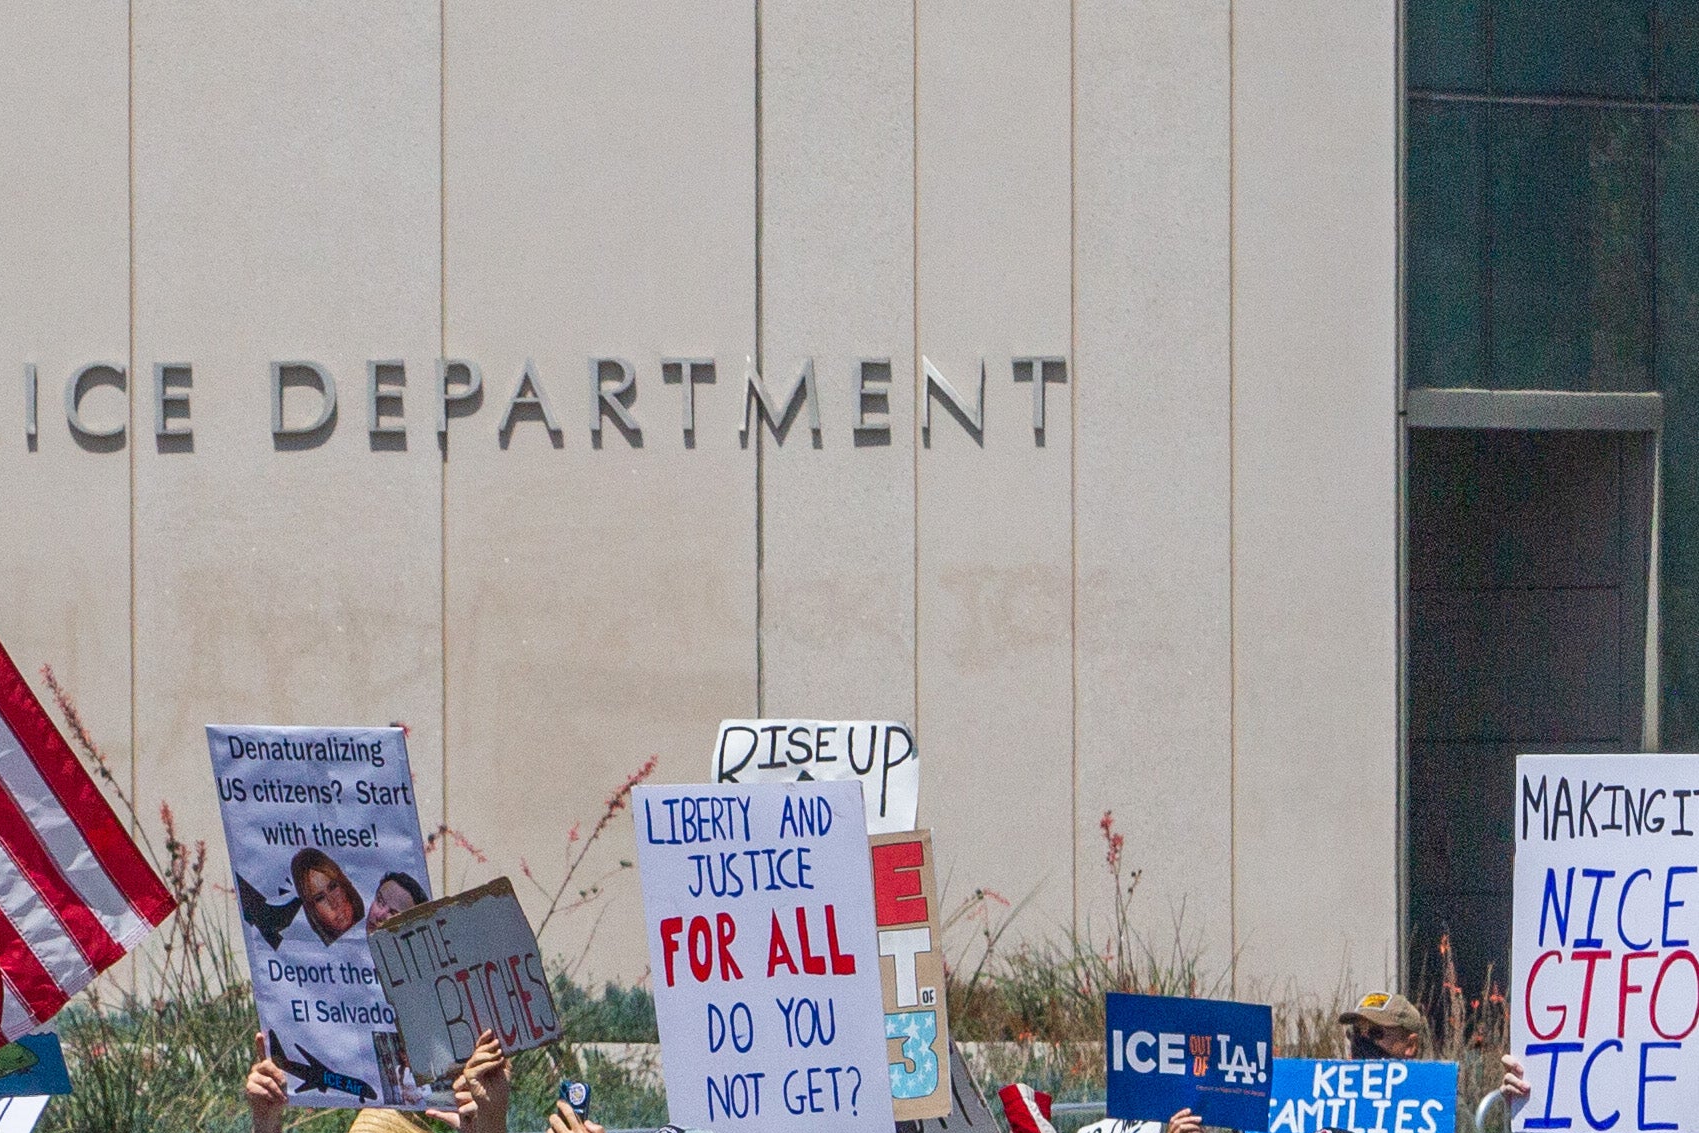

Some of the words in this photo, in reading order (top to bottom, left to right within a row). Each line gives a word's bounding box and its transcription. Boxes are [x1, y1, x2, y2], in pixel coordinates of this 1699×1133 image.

[270, 355, 1068, 452] DEPARTMENT
[228, 735, 385, 767] Denaturalizing
[217, 777, 247, 802] US
[253, 779, 343, 804] citizens?
[355, 780, 413, 806] Start
[1522, 774, 1667, 842] MAKING
[1672, 790, 1699, 837] I
[262, 821, 306, 847] with
[312, 823, 379, 848] these!
[645, 796, 751, 845] LIBERTY
[779, 795, 832, 839] AND
[688, 847, 814, 898] JUSTICE
[1538, 866, 1699, 951] NICE
[376, 920, 458, 988] LITTLE
[660, 911, 744, 987] FOR
[767, 904, 857, 978] ALL
[268, 959, 335, 988] Deport
[1525, 950, 1699, 1041] GTFO
[292, 1000, 311, 1023] El
[316, 999, 396, 1027] Salvado
[434, 953, 558, 1064] BITCHES
[708, 1002, 754, 1054] DO
[776, 997, 836, 1049] YOU
[1112, 1029, 1187, 1076] ICE
[1189, 1034, 1212, 1055] OUT
[1193, 1055, 1210, 1077] OF
[1217, 1034, 1268, 1084] LA!
[706, 1072, 766, 1122] NOT
[783, 1066, 862, 1118] GET?
[1312, 1062, 1408, 1100] KEEP
[1523, 1038, 1683, 1132] ICE
